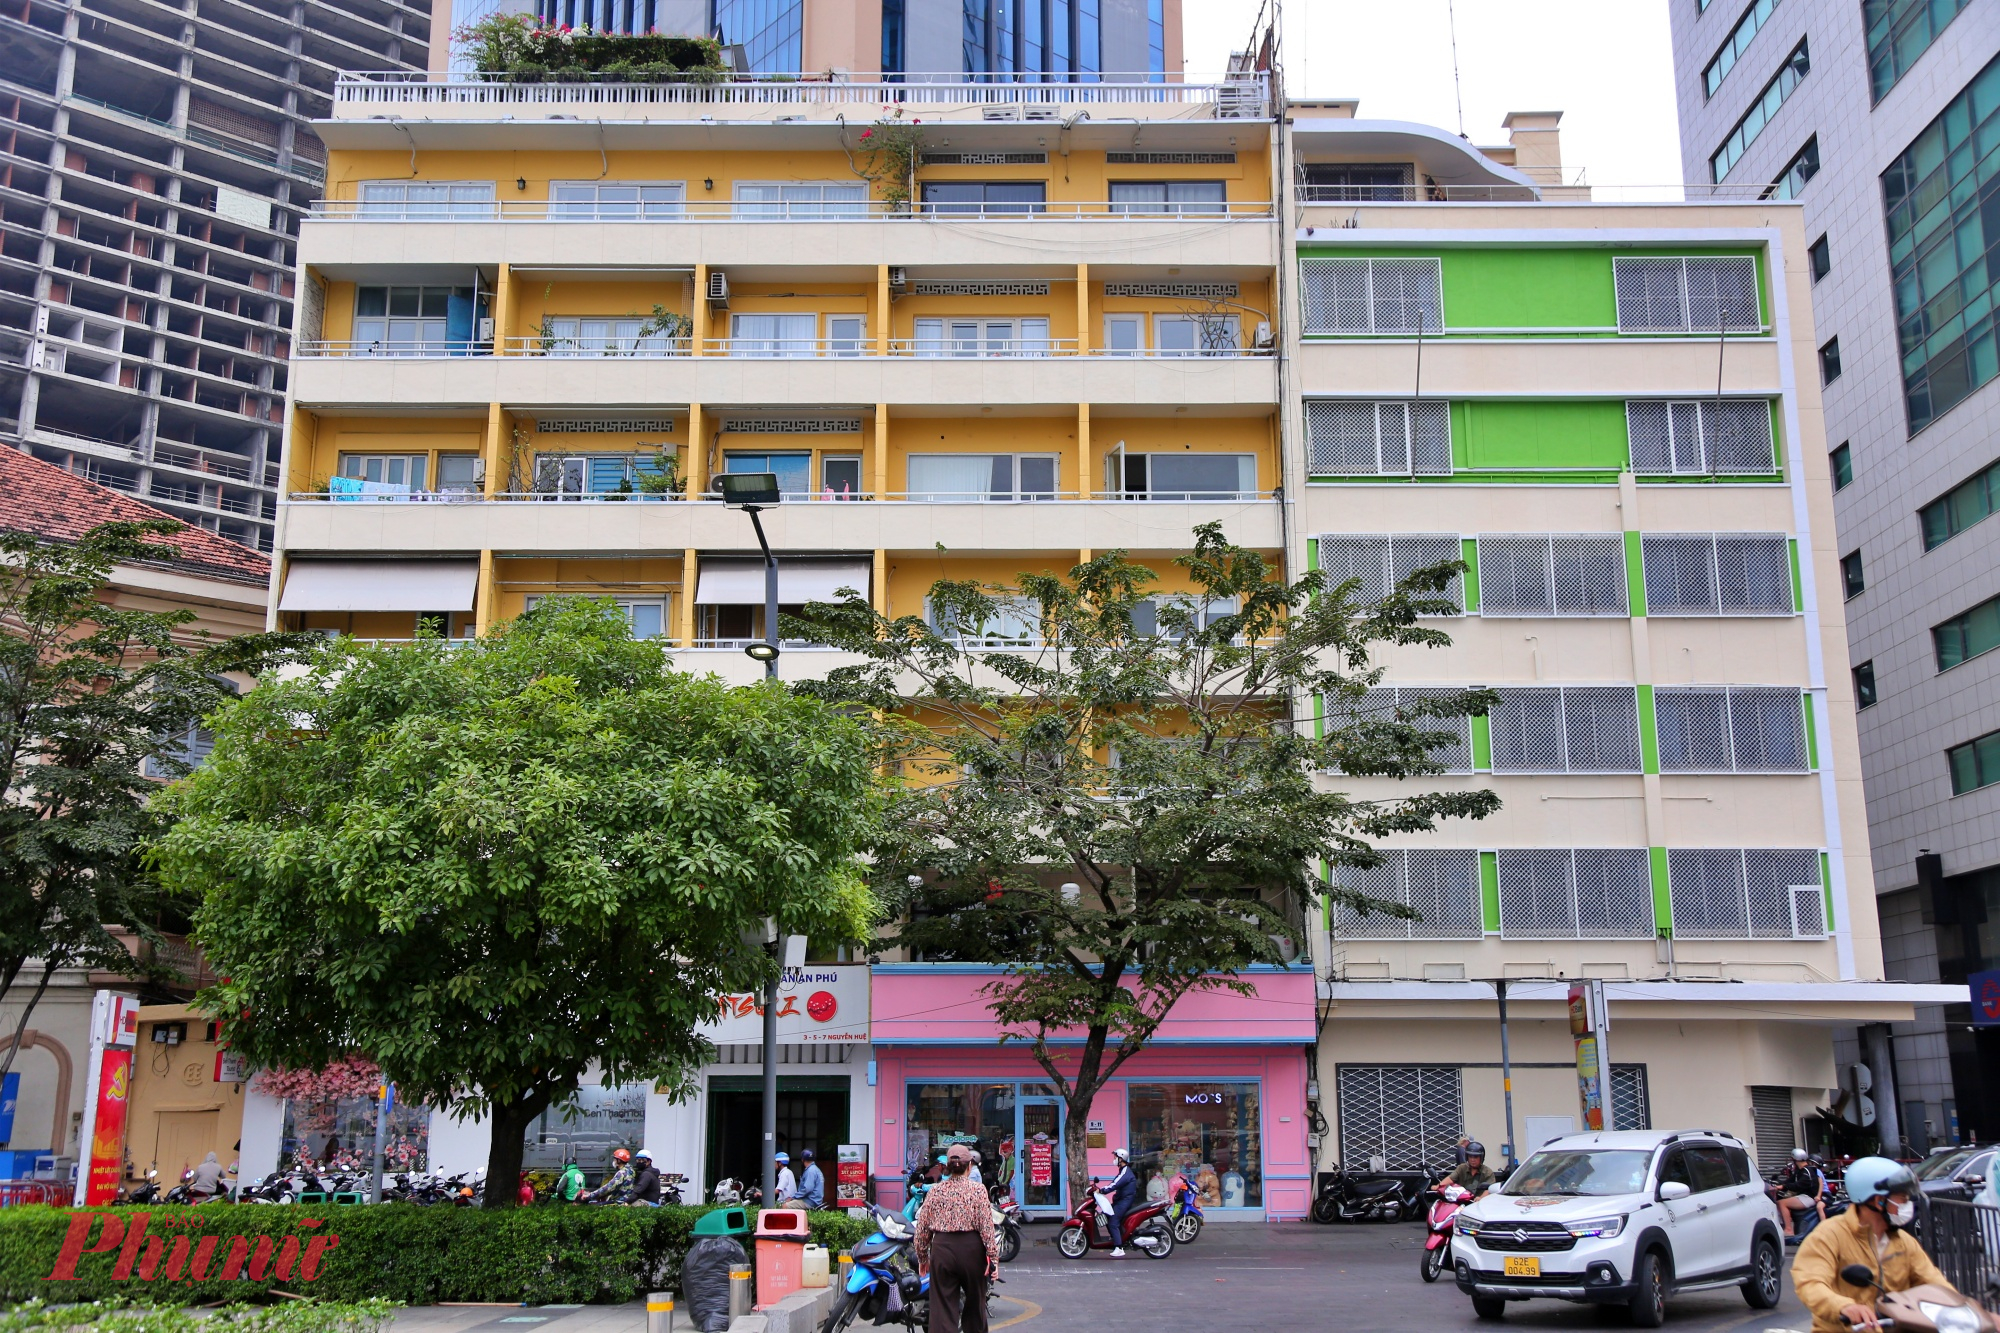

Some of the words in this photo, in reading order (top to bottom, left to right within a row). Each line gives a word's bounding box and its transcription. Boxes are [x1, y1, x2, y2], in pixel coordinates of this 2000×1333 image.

[798, 974, 813, 982] AN
[816, 971, 838, 982] PHÚ
[1513, 1257, 1529, 1266] 62E
[1508, 1266, 1536, 1276] 004.99
